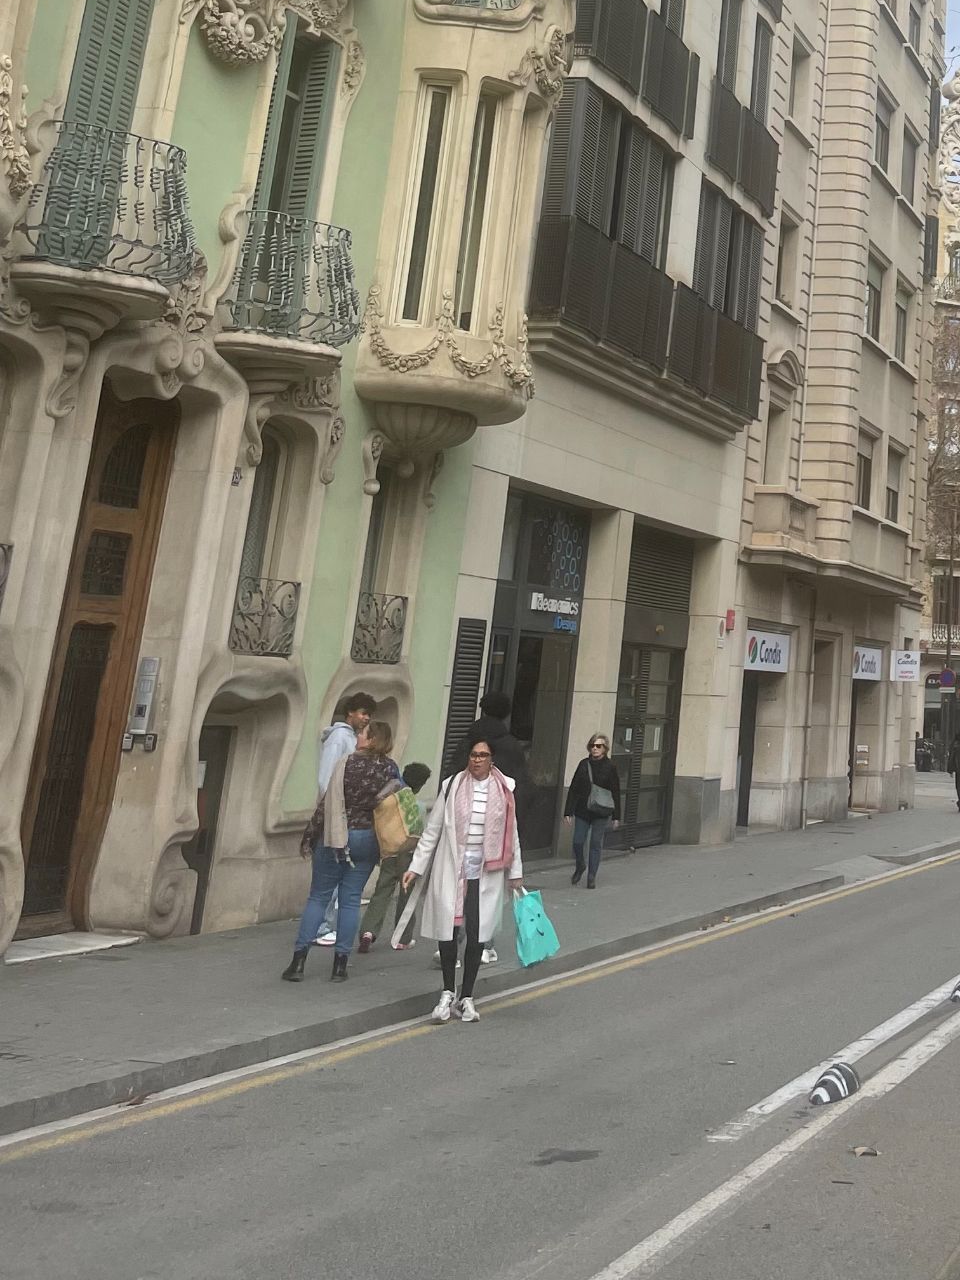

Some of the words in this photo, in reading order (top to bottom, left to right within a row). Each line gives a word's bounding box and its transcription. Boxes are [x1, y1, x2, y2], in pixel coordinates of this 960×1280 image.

[760, 639, 781, 665] Condis
[897, 658, 918, 666] Condis
[861, 653, 877, 674] Condis
